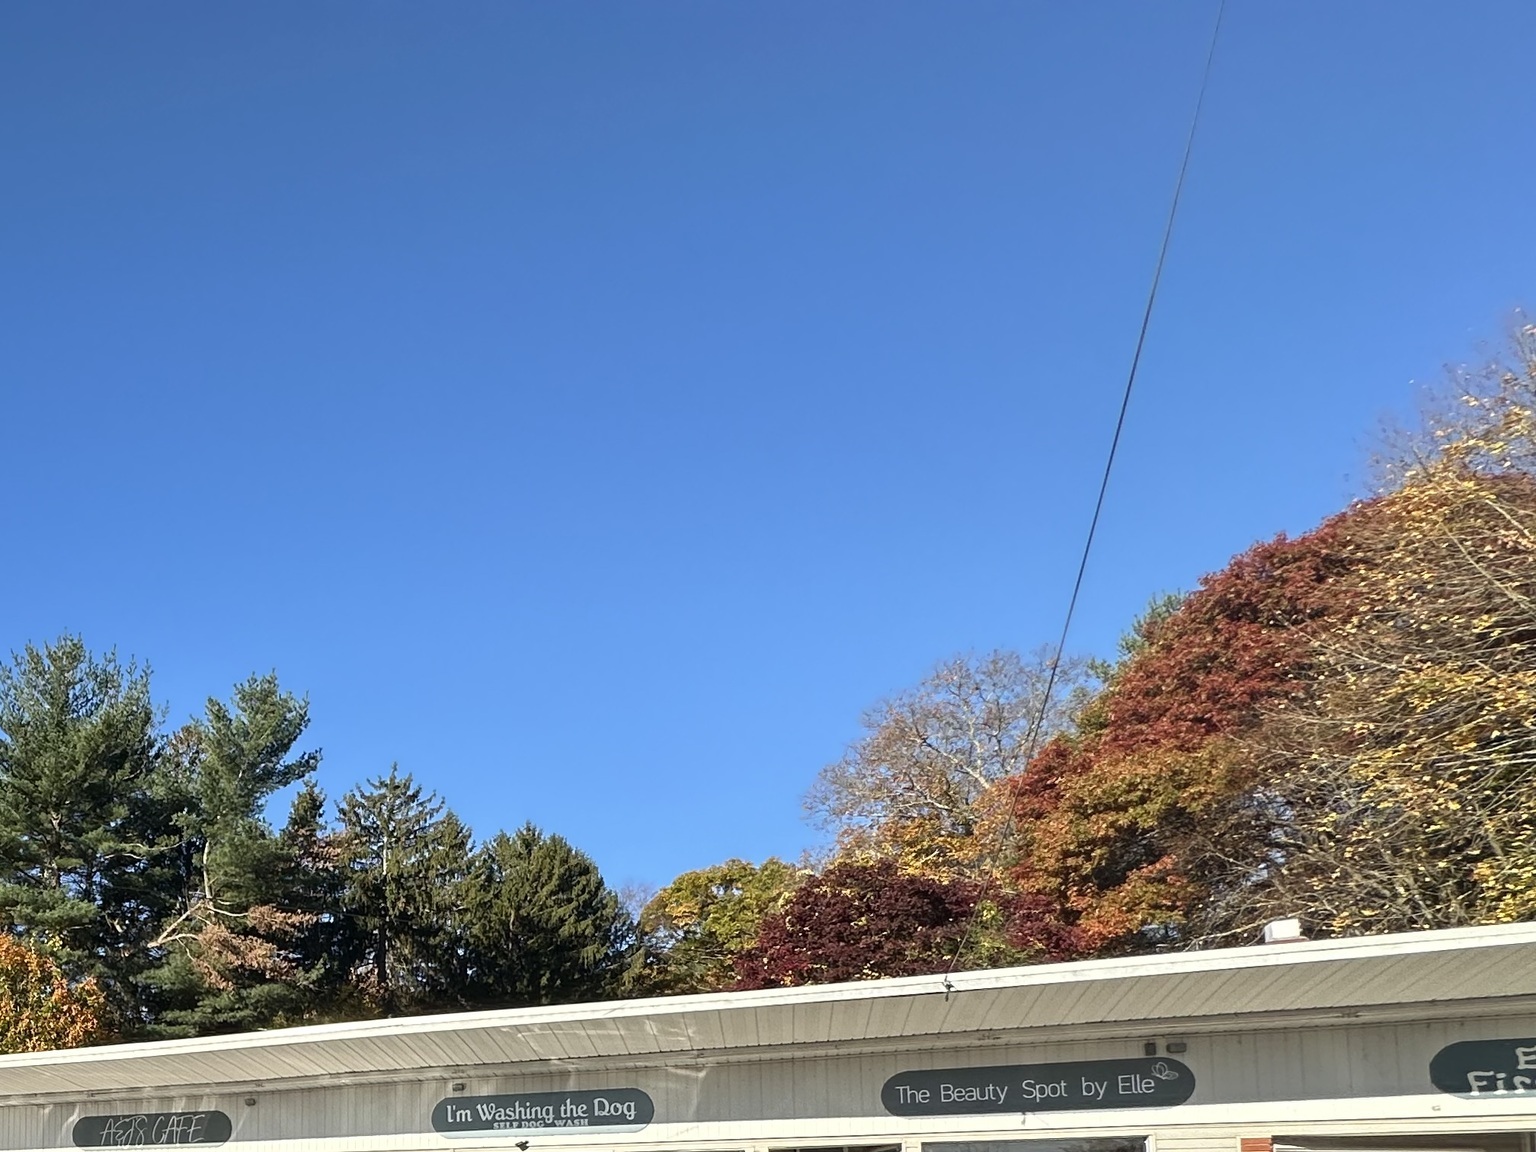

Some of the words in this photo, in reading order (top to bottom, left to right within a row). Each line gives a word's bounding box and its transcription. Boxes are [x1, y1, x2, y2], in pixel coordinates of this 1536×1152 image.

[895, 1086, 930, 1105] The
[941, 1083, 1008, 1105] Beauty
[1022, 1079, 1067, 1102] Spot
[1082, 1077, 1107, 1099] by
[1118, 1074, 1155, 1095] Elle
[446, 1105, 473, 1123] I'm
[476, 1101, 555, 1124] Washing
[560, 1098, 588, 1117] the
[594, 1097, 637, 1120] Dog
[493, 1121, 519, 1130] SELF
[522, 1121, 545, 1129] DOG
[554, 1118, 589, 1127] WASH
[152, 1114, 205, 1147] CAFE
